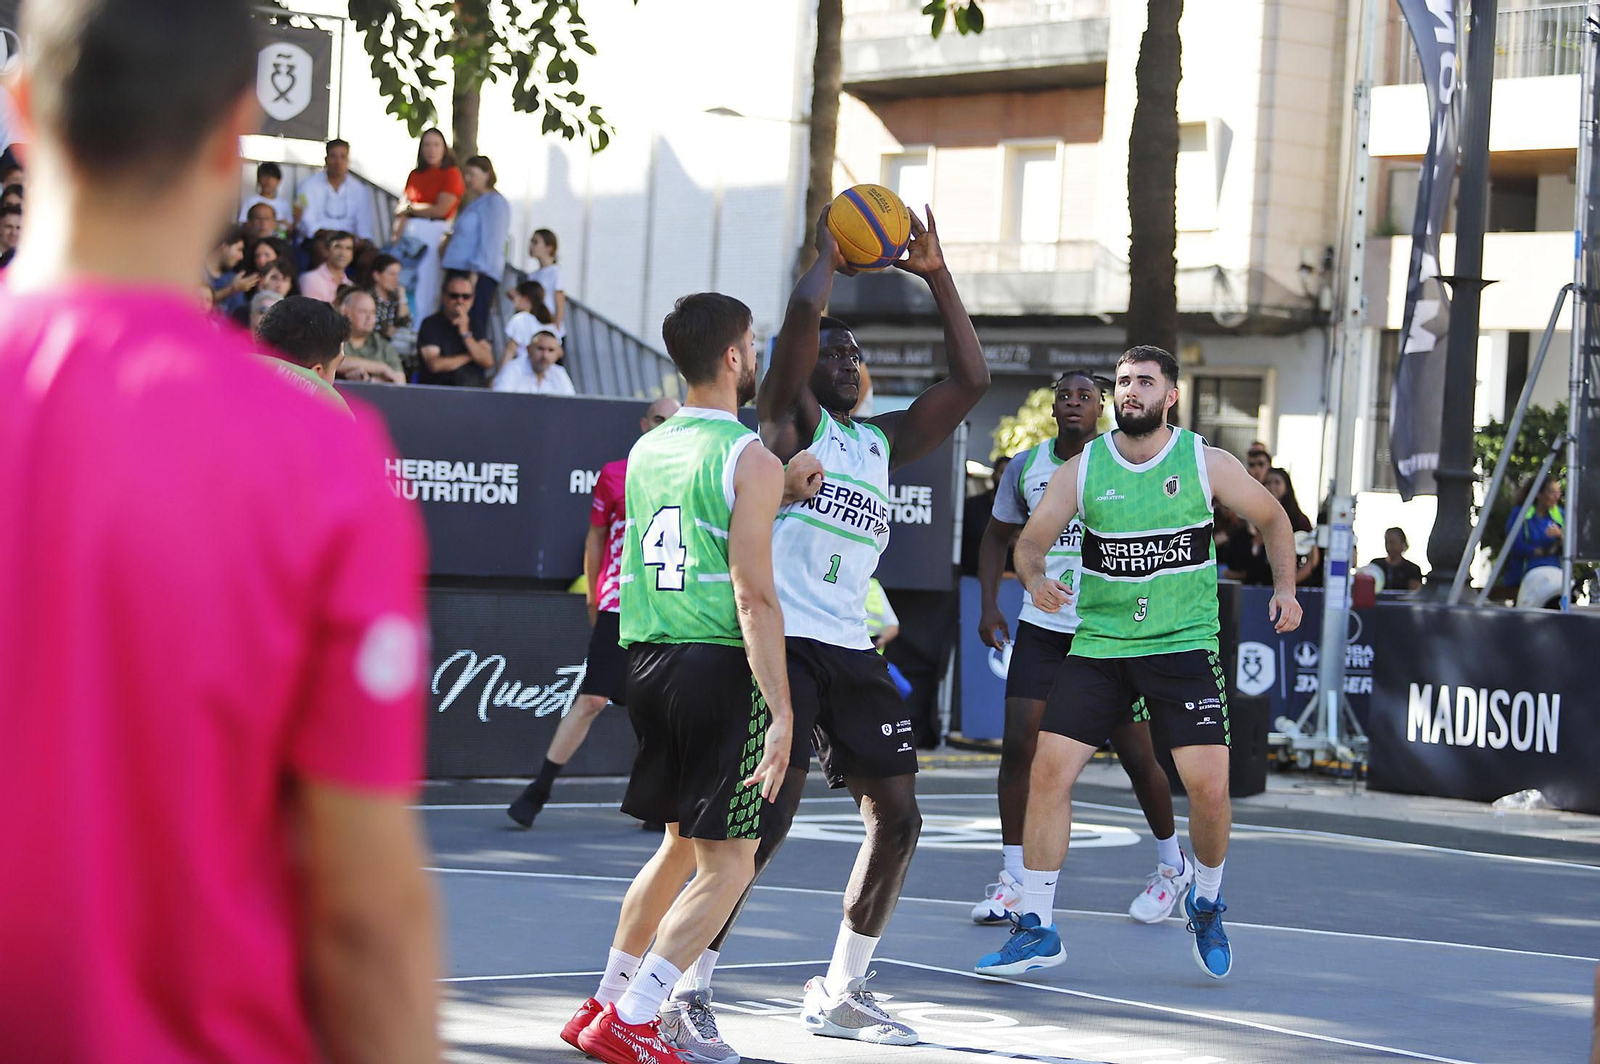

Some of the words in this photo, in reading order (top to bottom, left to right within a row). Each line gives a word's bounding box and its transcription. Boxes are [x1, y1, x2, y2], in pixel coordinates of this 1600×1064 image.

[385, 457, 519, 485] HERBALIFE
[642, 505, 687, 592] 4
[1101, 547, 1193, 572] NUTRITION
[823, 553, 842, 584] 1
[1060, 569, 1075, 591] 4
[1133, 597, 1149, 622] 3
[1407, 682, 1561, 754] MADISON
